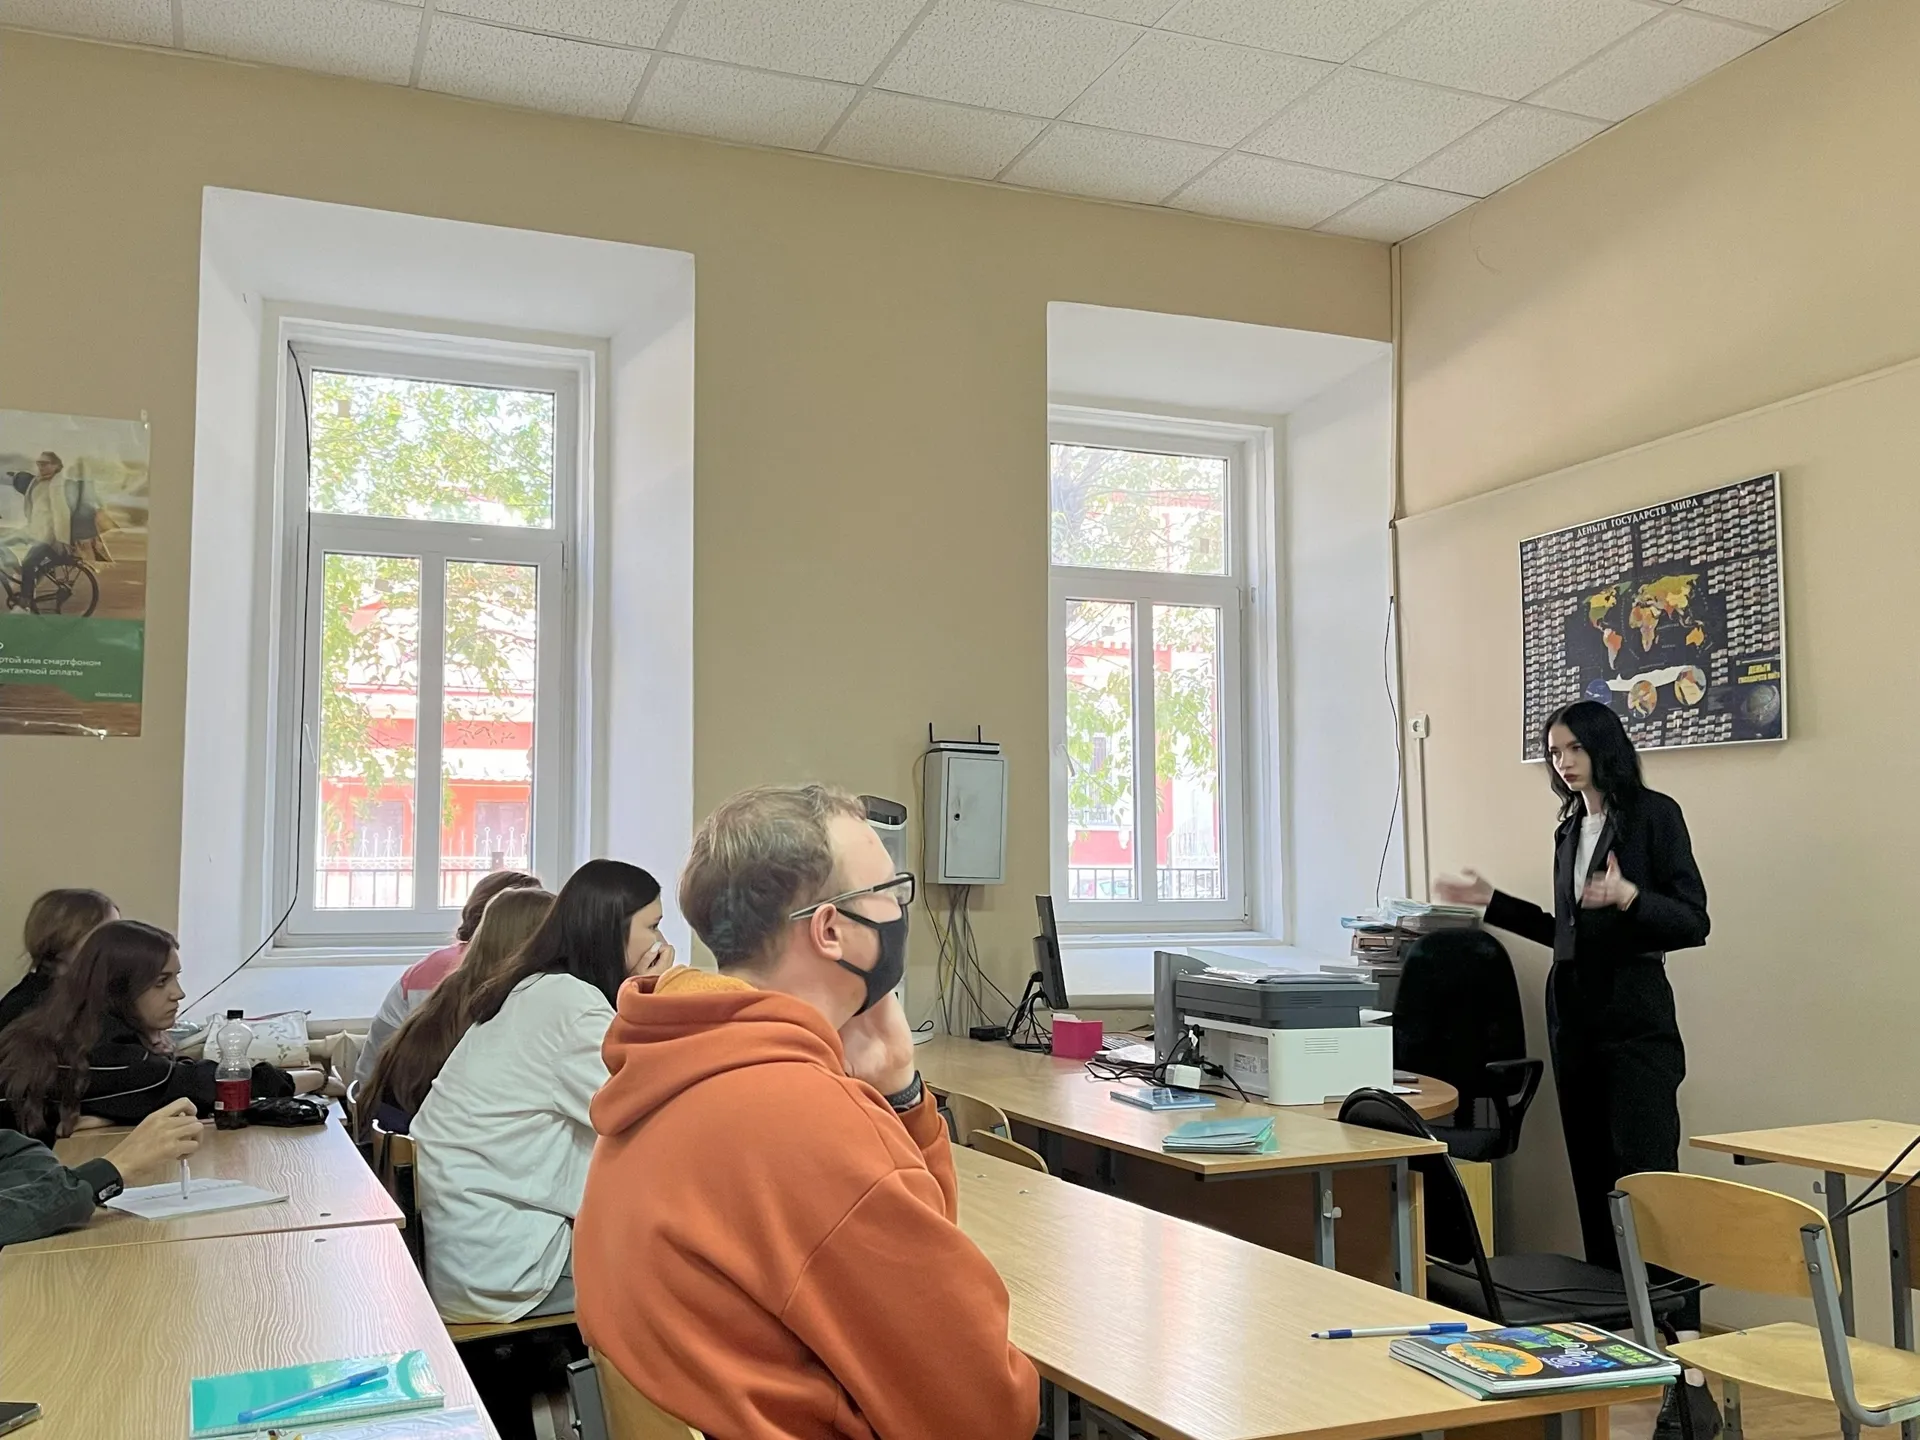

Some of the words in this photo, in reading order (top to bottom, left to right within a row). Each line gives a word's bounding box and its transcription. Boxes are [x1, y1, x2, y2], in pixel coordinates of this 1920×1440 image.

[1576, 522, 1608, 538] ДЕНЬГИ
[1611, 506, 1667, 528] ГОСУДАРСТВ
[1670, 498, 1699, 513] МИРА
[23, 657, 41, 665] или
[43, 657, 101, 667] смартфоном
